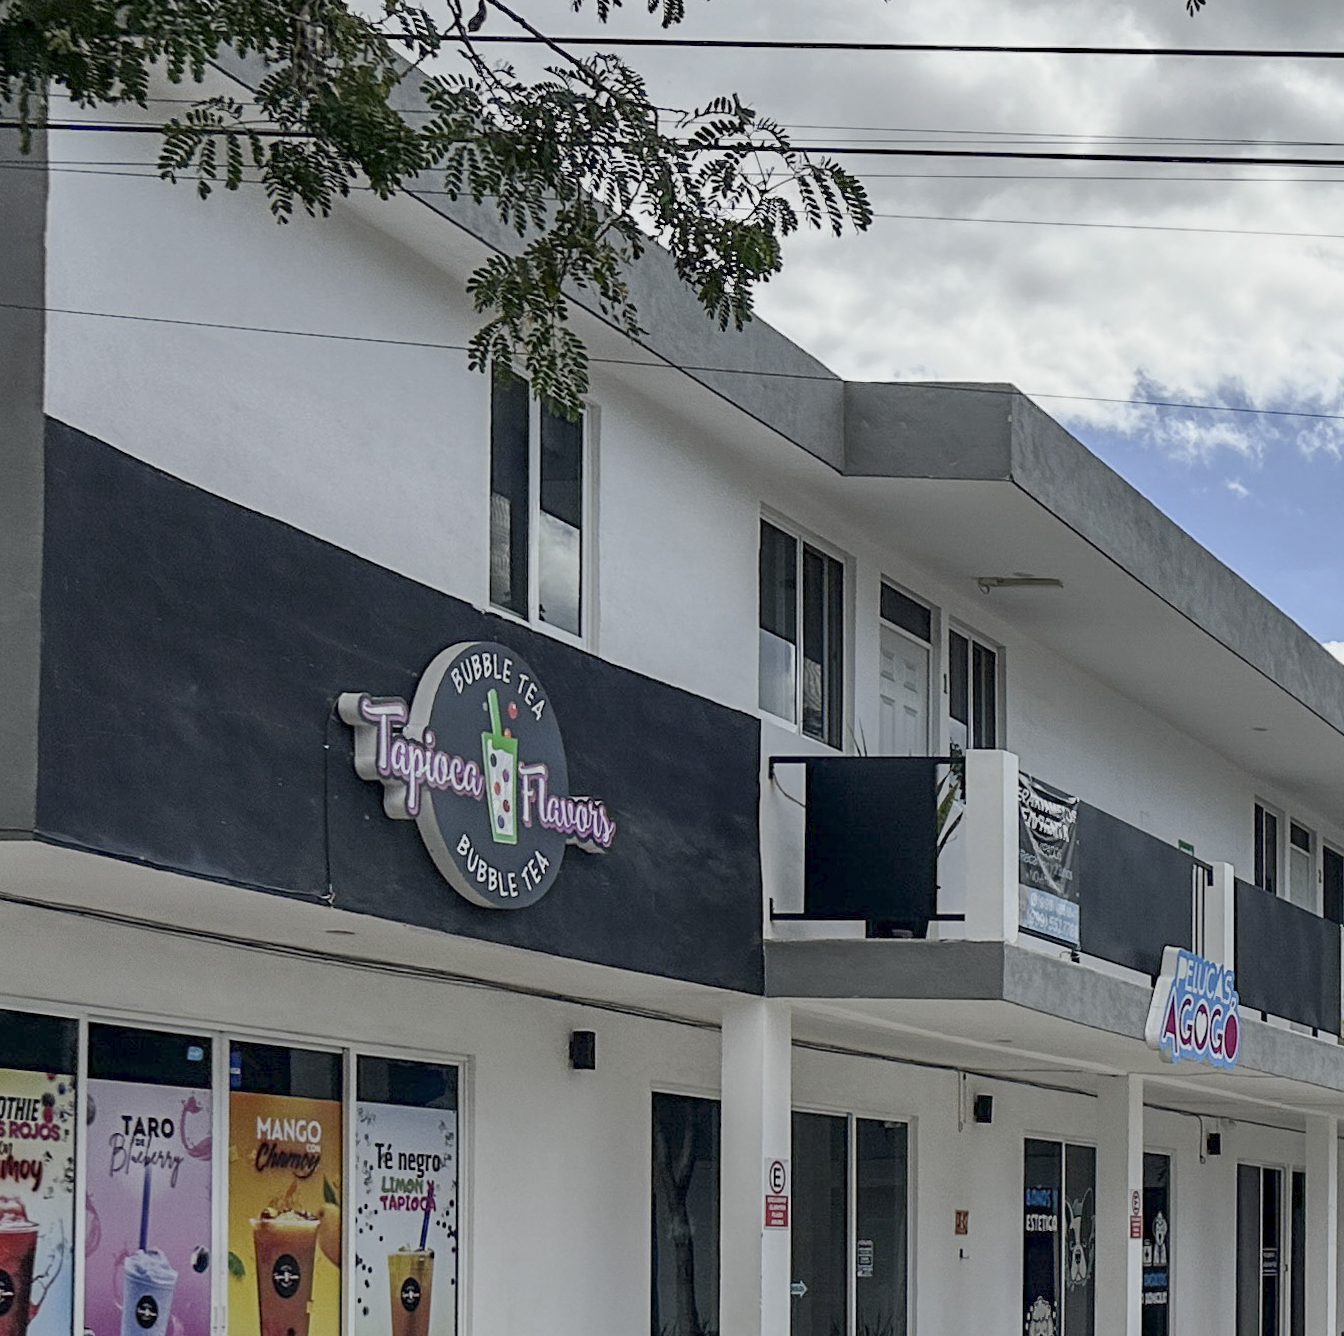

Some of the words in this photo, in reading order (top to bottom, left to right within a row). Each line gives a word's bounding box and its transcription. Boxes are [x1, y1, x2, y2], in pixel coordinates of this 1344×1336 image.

[451, 652, 513, 694] BUBBLE
[518, 673, 548, 721] TEA
[361, 698, 485, 816] Tapioca
[518, 761, 617, 848] Flavors
[456, 833, 520, 899] BUBBLE
[521, 850, 550, 892] TEA
[1176, 956, 1233, 1005] PELUCAS
[9, 1121, 61, 1141] ROJOS
[121, 1115, 174, 1139] TARO
[256, 1115, 322, 1143] MANGO
[109, 1132, 184, 1188] Blueberry
[255, 1141, 321, 1179] Chamoy
[375, 1142, 393, 1170] Té
[398, 1149, 440, 1179] negro
[773, 1167, 781, 1188] E
[379, 1195, 437, 1213] TAPIOCA
